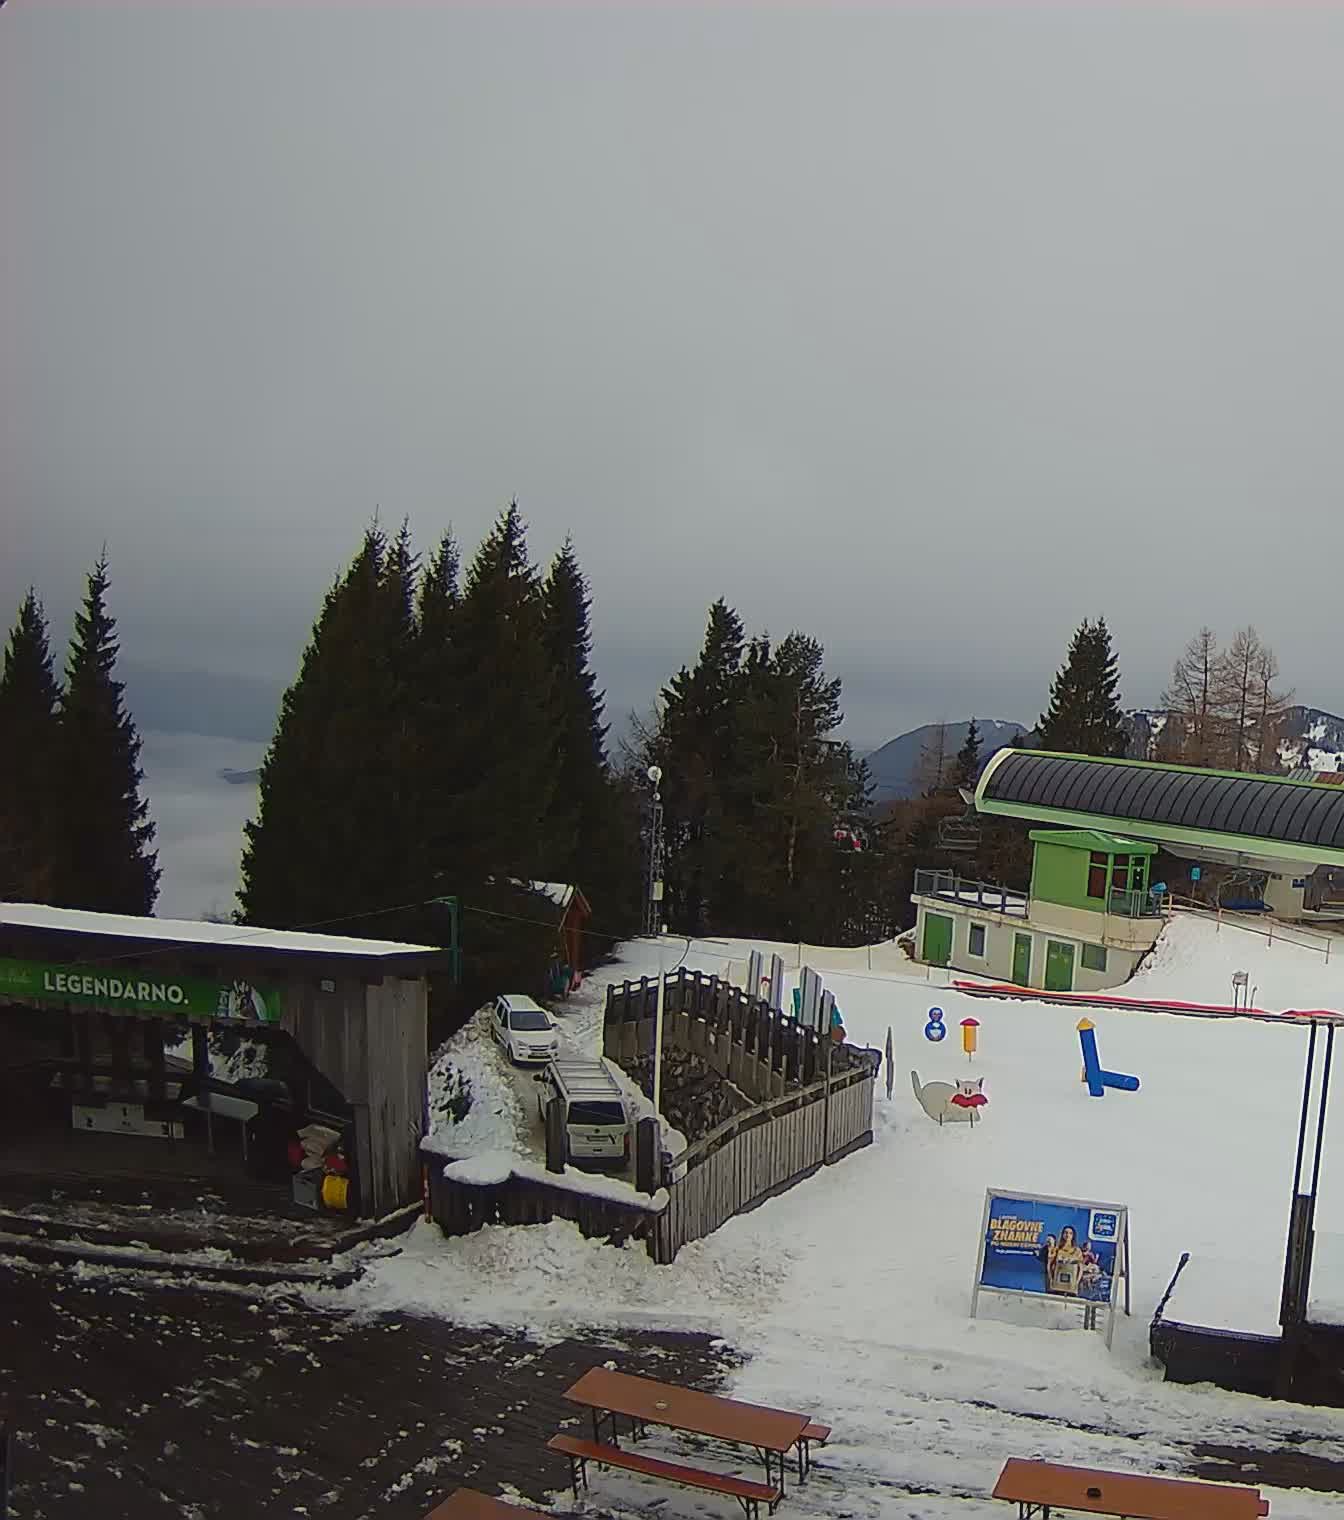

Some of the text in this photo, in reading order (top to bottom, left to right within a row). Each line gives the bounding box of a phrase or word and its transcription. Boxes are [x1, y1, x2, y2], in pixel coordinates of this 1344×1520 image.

[43, 971, 190, 1005] LEGENDARNO.
[990, 1218, 1044, 1233] BLAGOVNE
[992, 1230, 1039, 1243] ZNAMKE
